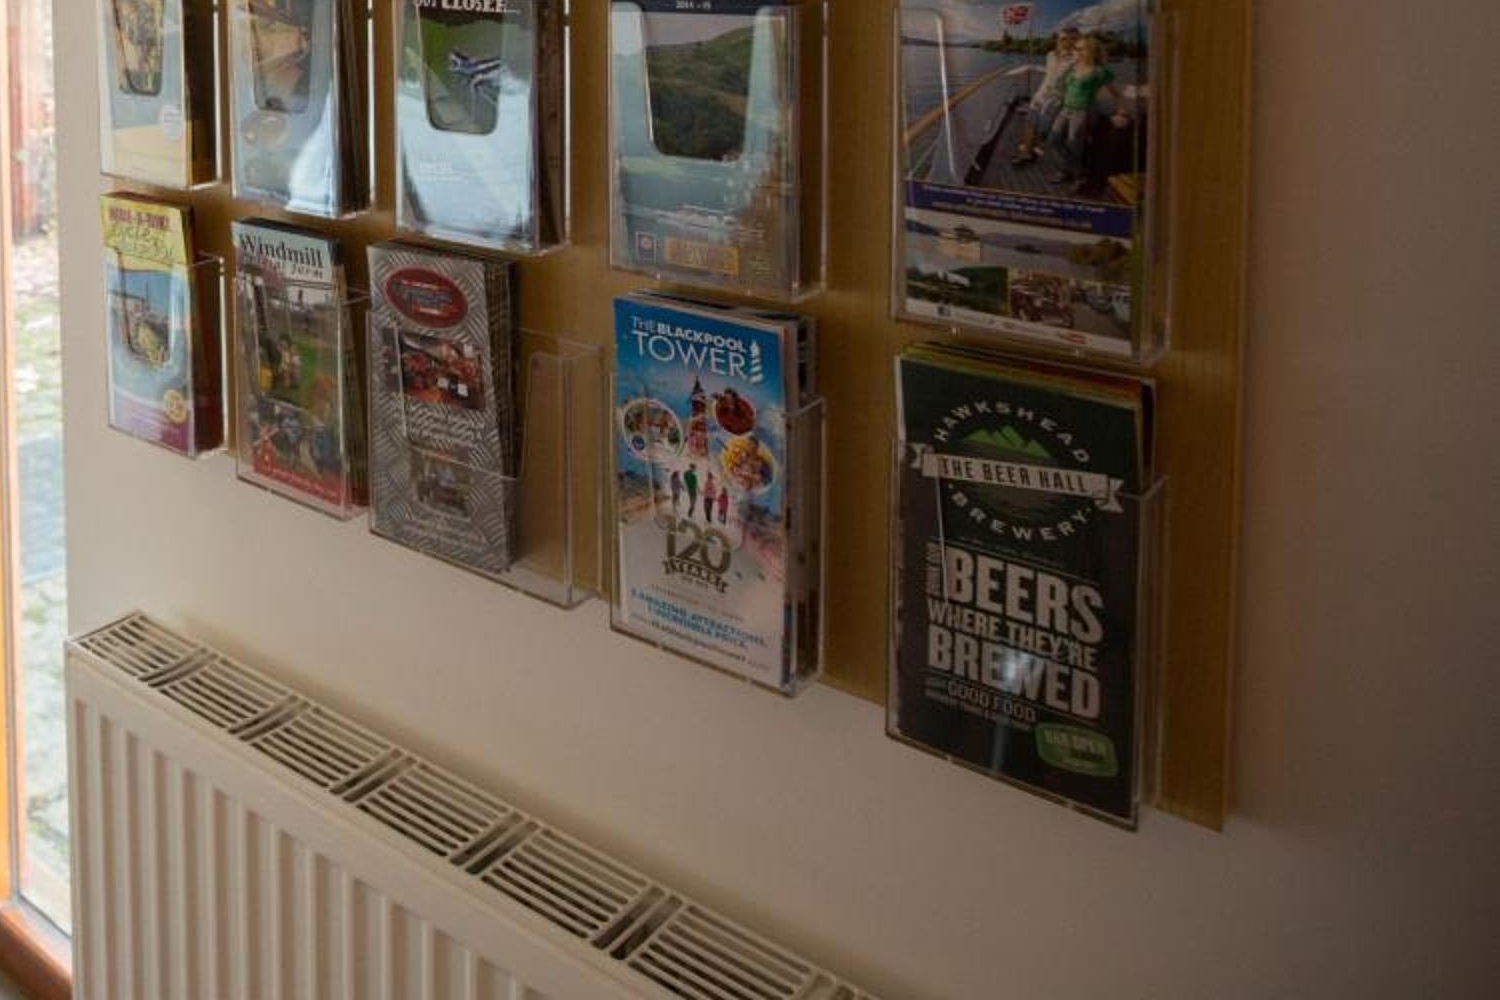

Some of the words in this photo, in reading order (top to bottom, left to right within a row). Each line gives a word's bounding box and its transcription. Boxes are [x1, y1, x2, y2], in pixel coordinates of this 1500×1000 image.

[631, 330, 749, 383] TOWER
[656, 322, 748, 354] BLACKPOOL
[933, 400, 1090, 463] HAWKSHEAD
[938, 457, 973, 478] THE
[983, 463, 1031, 486] BEER
[1039, 471, 1086, 493] HALL
[947, 548, 1104, 644] BEERS
[927, 597, 1000, 641] WHERE
[1005, 620, 1098, 671] THEY'RE
[927, 625, 1100, 719] BREWED
[947, 680, 987, 706] GOOD
[992, 699, 1037, 722] FOOD
